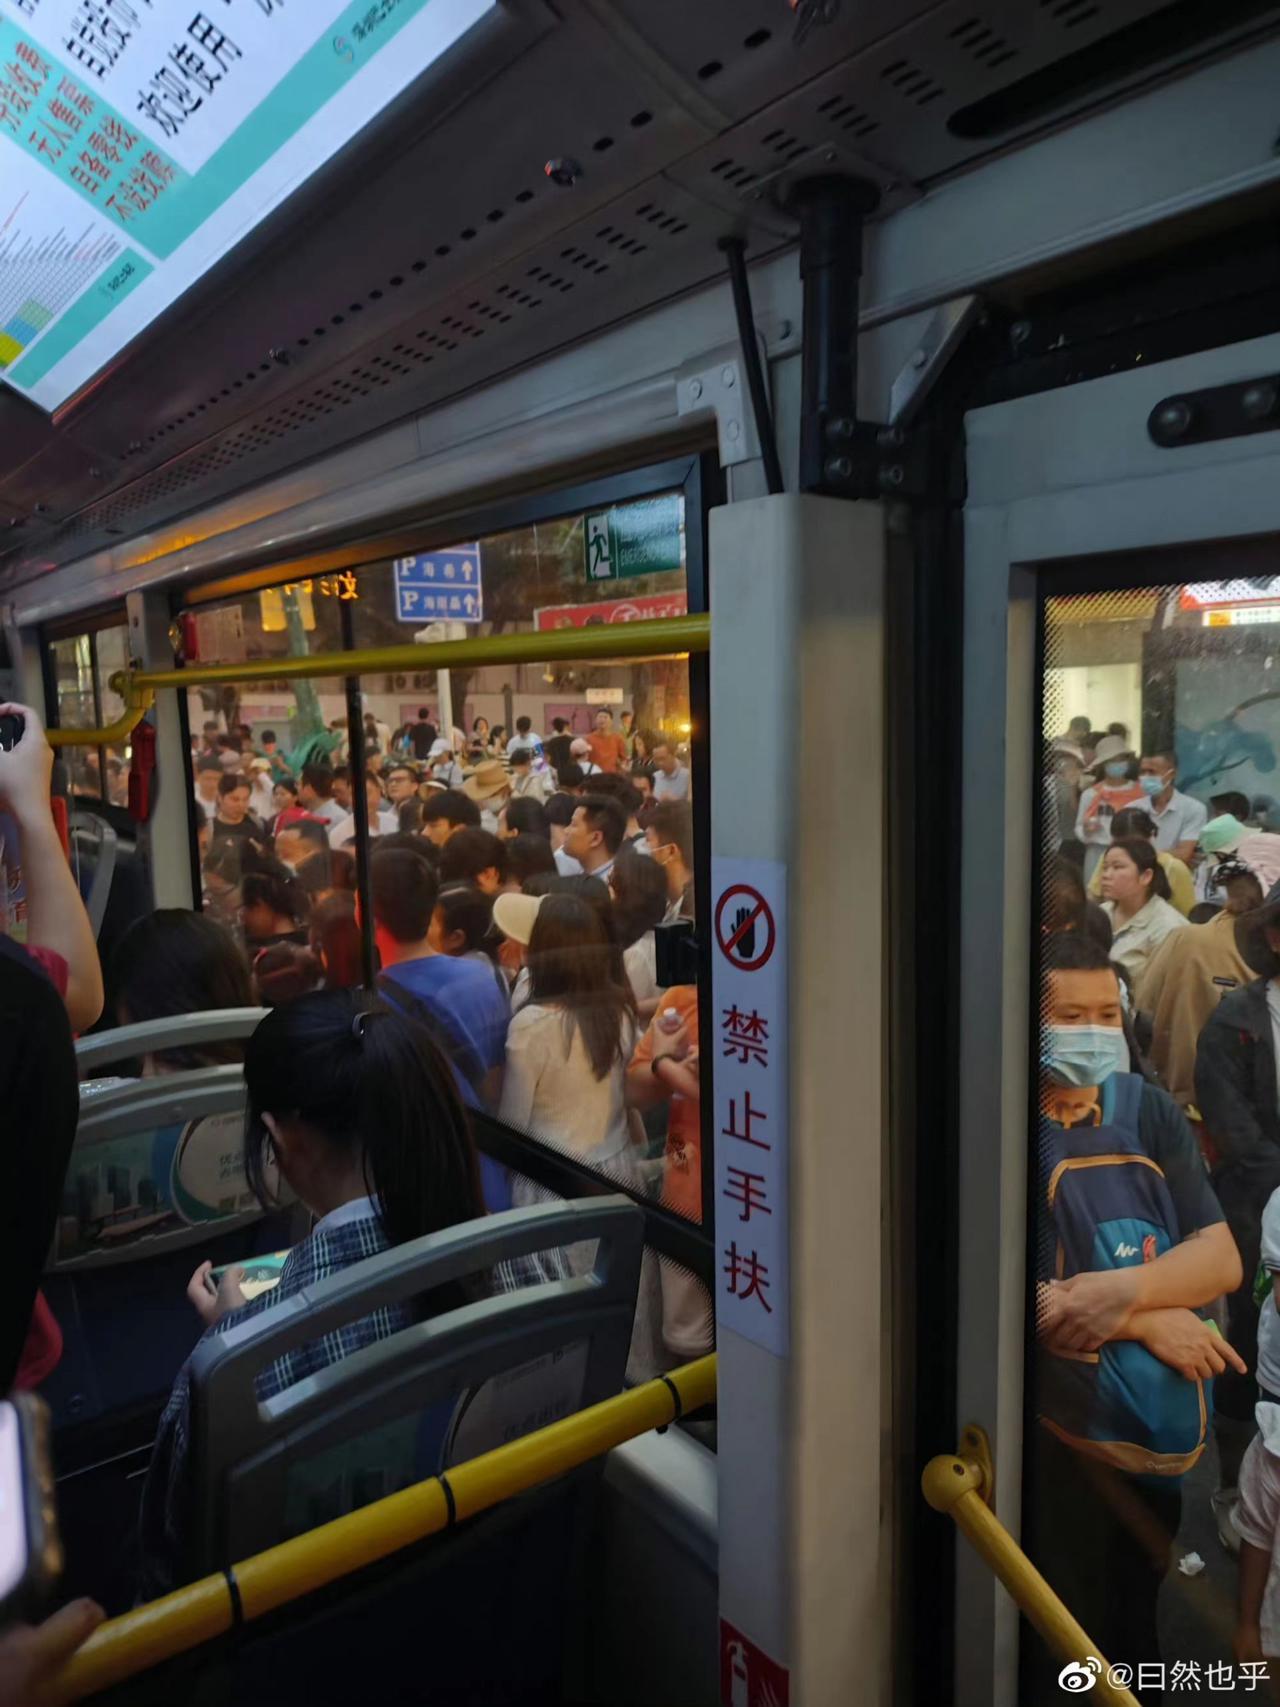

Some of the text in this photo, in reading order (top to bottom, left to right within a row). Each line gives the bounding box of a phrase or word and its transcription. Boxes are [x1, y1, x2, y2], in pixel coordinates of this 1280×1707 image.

[29, 74, 94, 164] 无人售票
[136, 11, 242, 138] 欢迎使用
[402, 590, 419, 611] P
[721, 1004, 773, 1314] 禁止手扶
